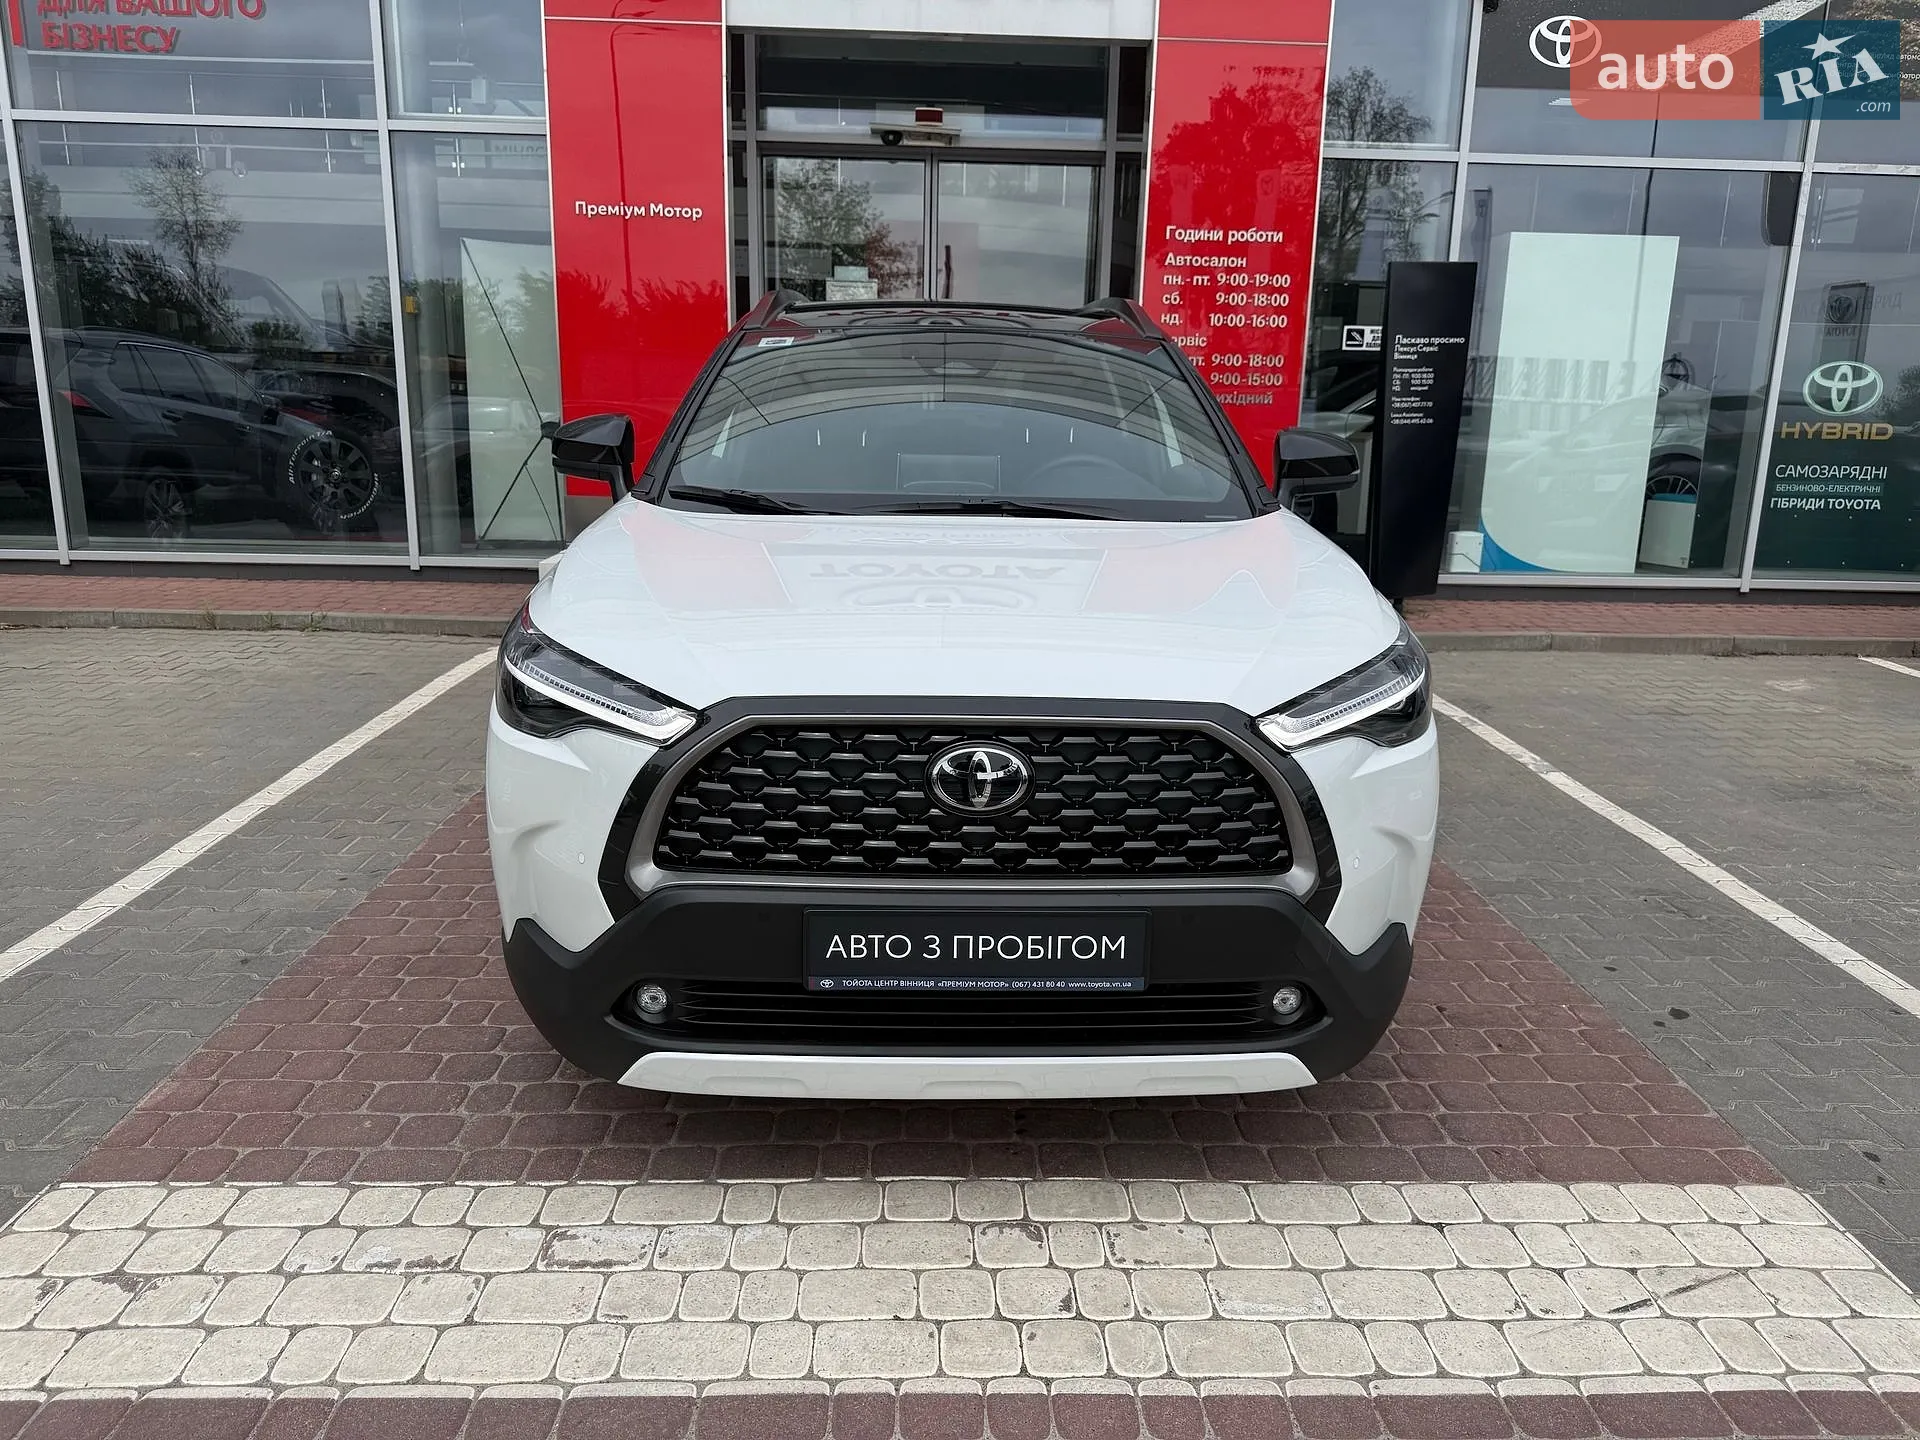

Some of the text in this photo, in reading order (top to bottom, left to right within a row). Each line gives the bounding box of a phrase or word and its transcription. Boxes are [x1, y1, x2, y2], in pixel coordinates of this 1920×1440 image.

[41, 22, 178, 53] БІЗНЕСУ
[575, 201, 703, 221] Преміум Мотор
[1165, 225, 1283, 245] Години роботи
[1164, 252, 1247, 268] Автосалон
[1162, 291, 1184, 305] сб.
[1160, 313, 1184, 326] нд.
[1172, 333, 1208, 348] рвіс
[1395, 334, 1465, 345] Ласкаво просимо
[1216, 391, 1274, 406] ихідний
[1780, 421, 1895, 441] HYBRID
[1775, 464, 1888, 481] САМОЗАРЯДНІ
[1776, 483, 1882, 494] БЕНЗИНОВО-ЕЛЕКТРИЧНІ
[1770, 497, 1881, 511] ГІБРИДИ TOYOTA
[825, 934, 1126, 960] АВТО З ПРОБІГОМ
[842, 979, 873, 987] ТОЙОТА
[874, 980, 899, 988] ЦЕНТР
[937, 980, 976, 988] «ПРЕМІУМ
[1011, 980, 1031, 989] (067)
[1068, 981, 1132, 989] www.toyota.vn.ua
